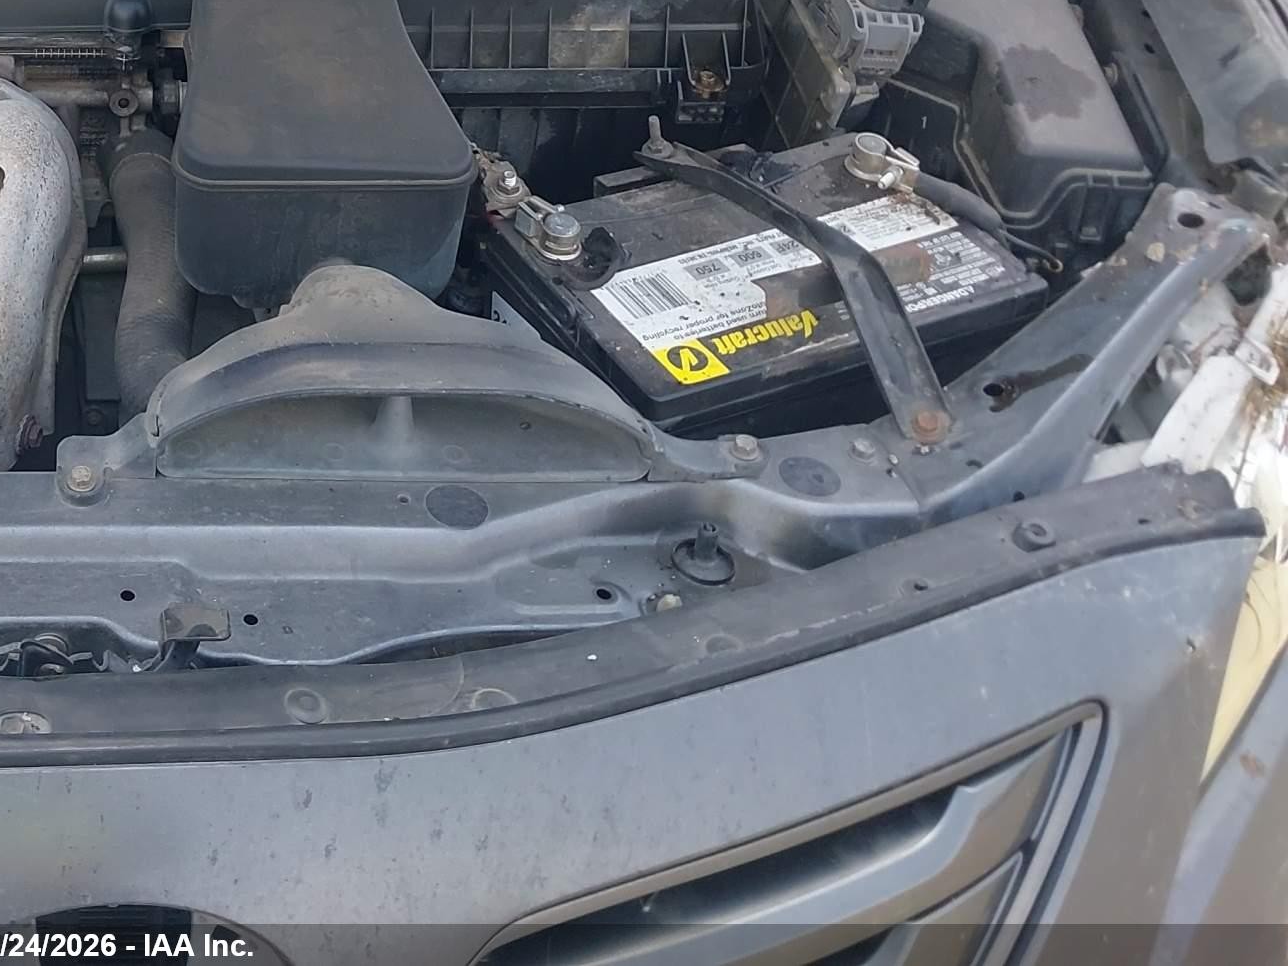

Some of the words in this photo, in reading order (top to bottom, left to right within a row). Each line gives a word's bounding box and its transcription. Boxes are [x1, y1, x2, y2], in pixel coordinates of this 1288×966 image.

[692, 262, 721, 275] 750
[681, 322, 725, 337] batteries
[683, 315, 715, 329] proper
[640, 324, 685, 341] recycling
[712, 310, 819, 355] Valucraft
